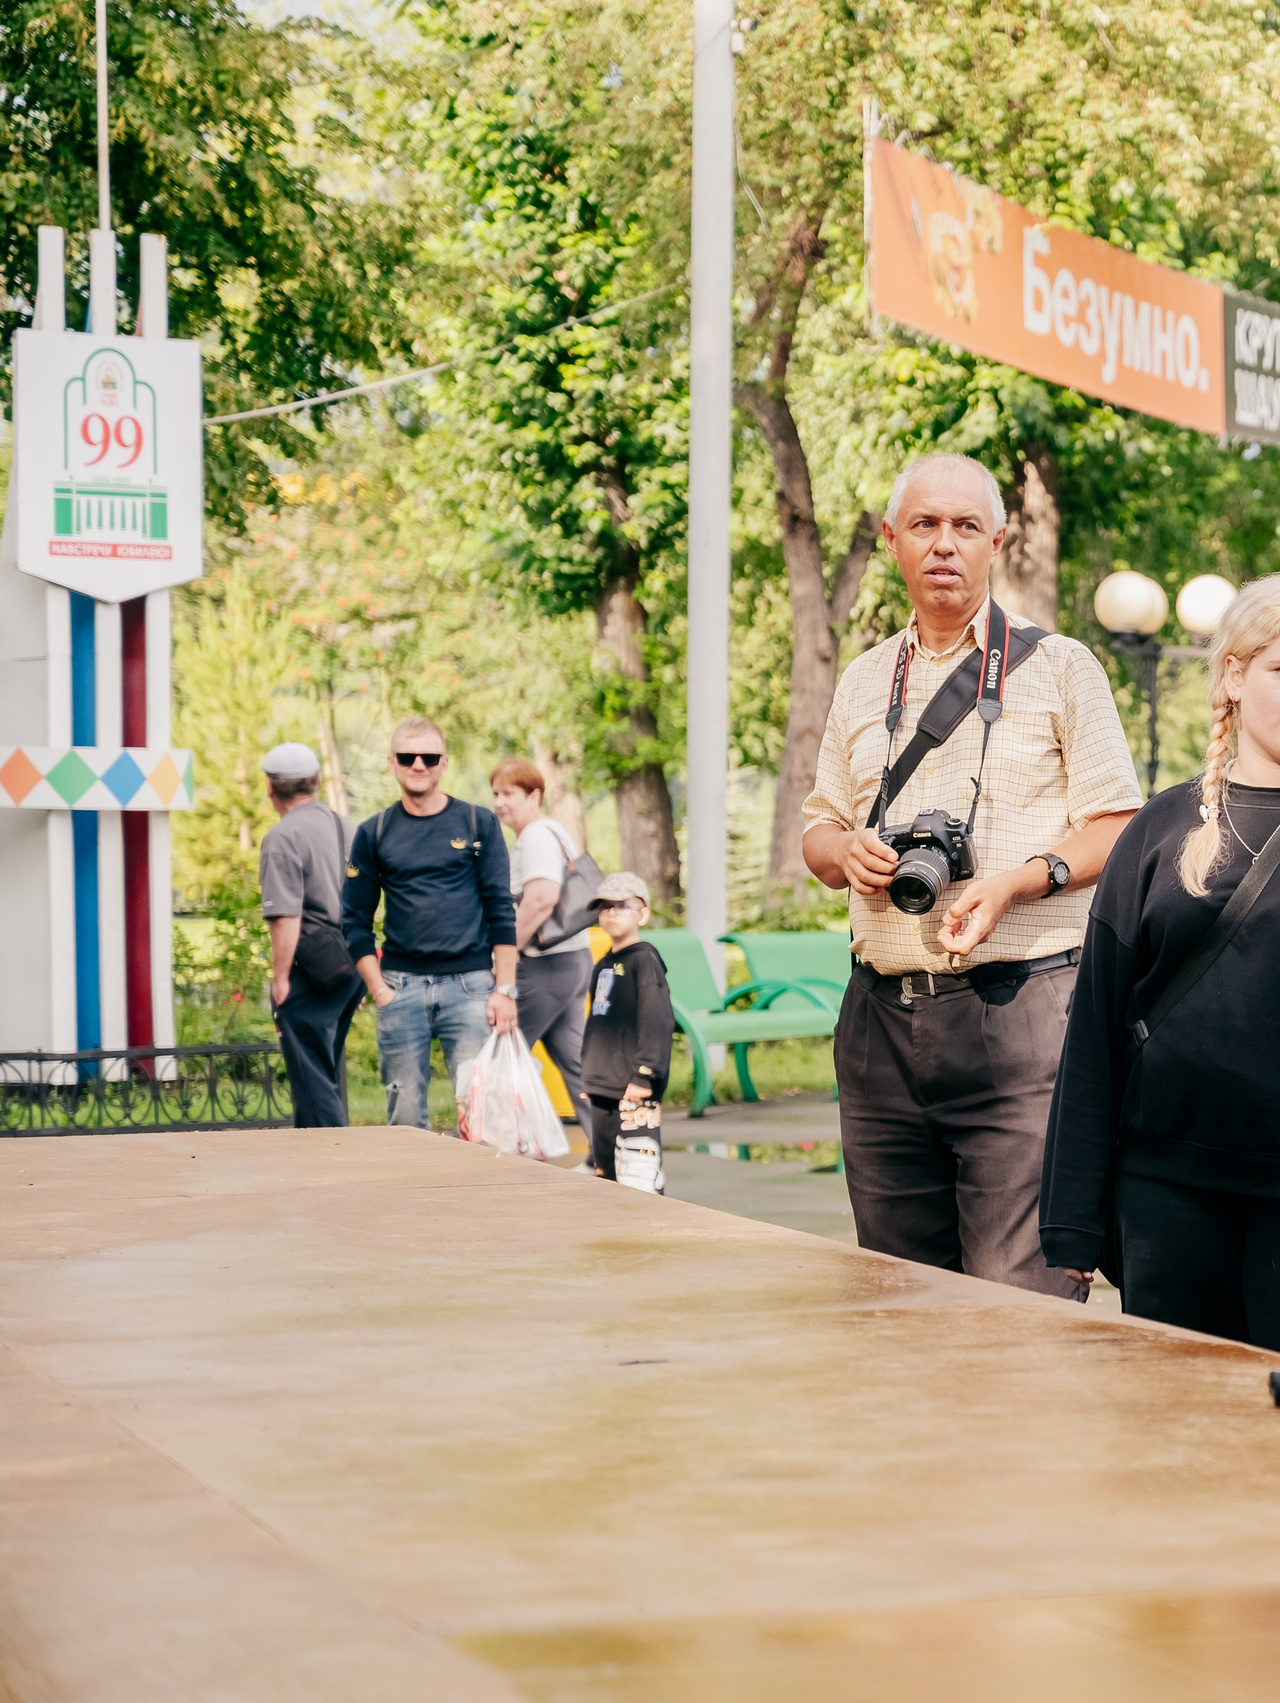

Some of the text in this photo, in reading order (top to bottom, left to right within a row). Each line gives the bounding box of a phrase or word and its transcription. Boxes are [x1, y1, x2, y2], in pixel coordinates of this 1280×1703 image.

[1021, 223, 1210, 392] Безумно.
[80, 412, 144, 469] 99
[51, 542, 112, 557] НАВСТРЕЧУ
[896, 664, 905, 680] 5D
[986, 648, 1002, 689] Canon
